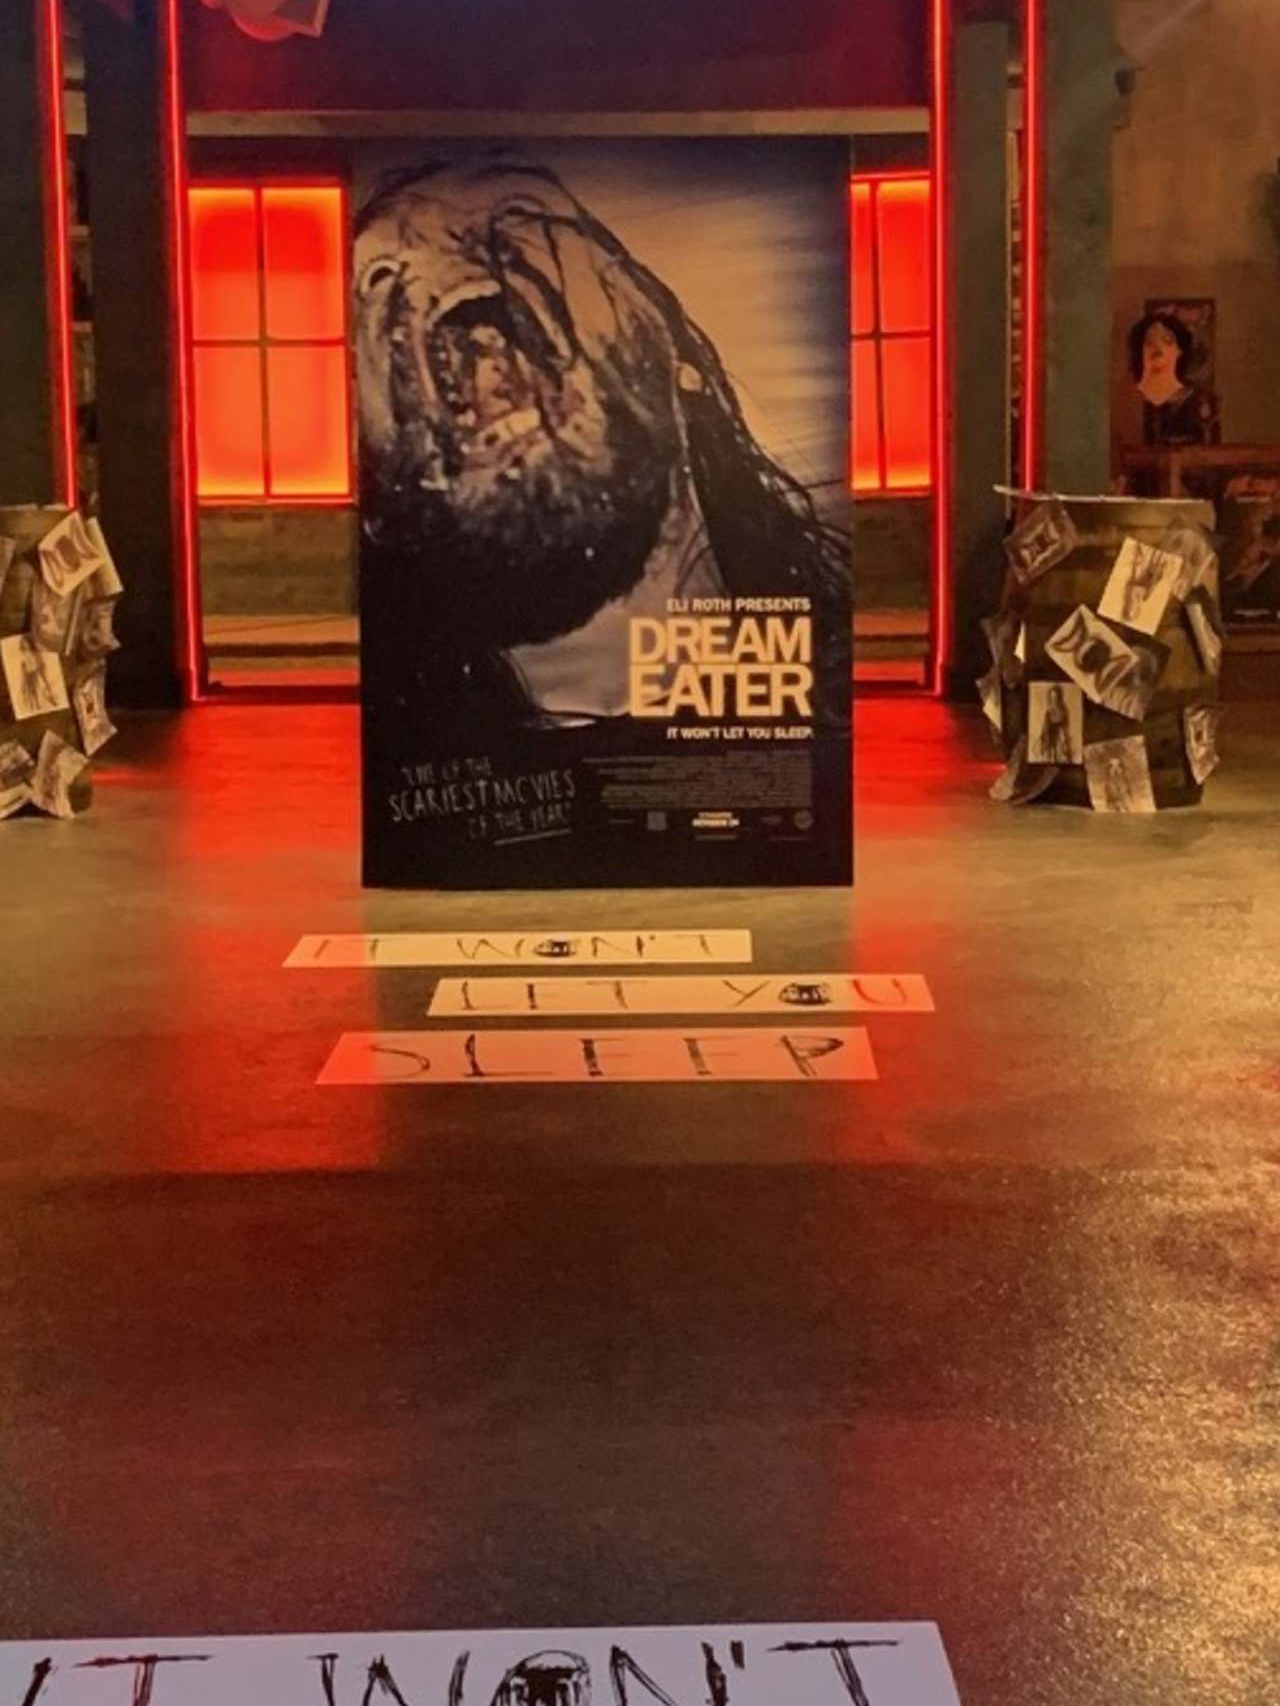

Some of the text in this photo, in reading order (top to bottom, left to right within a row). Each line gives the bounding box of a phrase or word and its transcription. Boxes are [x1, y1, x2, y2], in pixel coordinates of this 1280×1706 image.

[667, 597, 811, 612] ELI ROTH PRESENTS
[629, 616, 812, 664] DREAM
[629, 664, 814, 717] EATER
[667, 727, 678, 740] IT
[723, 727, 745, 740] LET
[746, 727, 771, 740] YOU
[388, 780, 488, 822] SCARIEST
[456, 934, 713, 959] WON'T
[719, 978, 910, 1008] YOU
[360, 1033, 846, 1078] SLEEP
